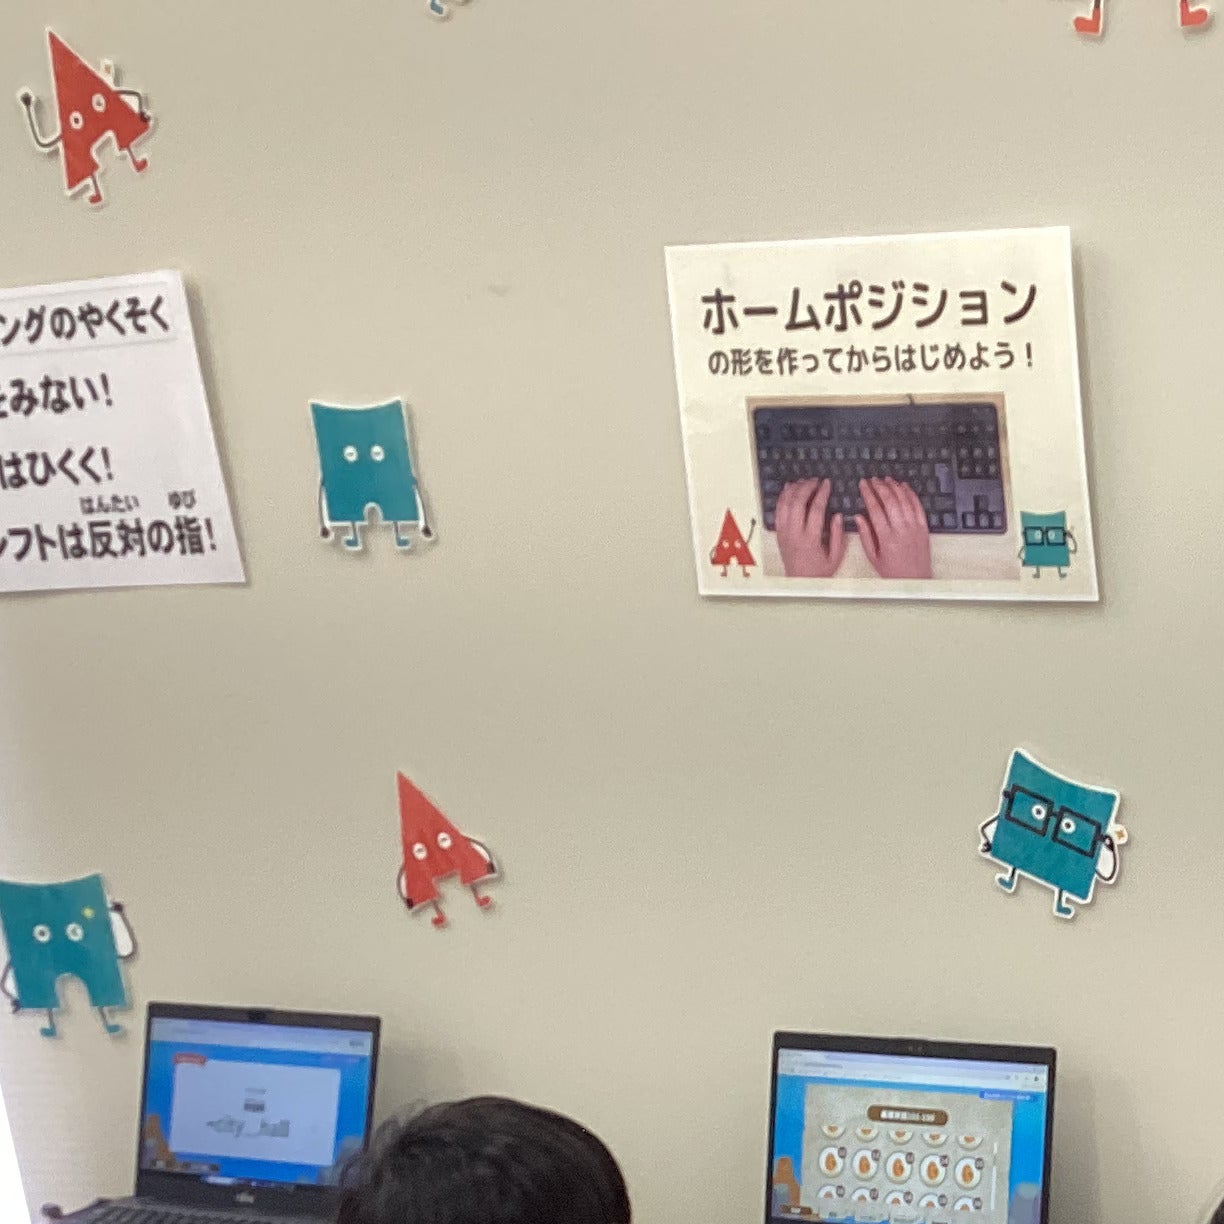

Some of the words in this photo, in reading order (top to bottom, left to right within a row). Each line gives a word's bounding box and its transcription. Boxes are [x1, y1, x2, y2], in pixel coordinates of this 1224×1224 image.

[700, 280, 1037, 335] ホームポジション
[708, 341, 1034, 377] の形を作ってからはじめよう！
[80, 494, 139, 515] はんたい
[0, 515, 217, 562] フトは反対の指!
